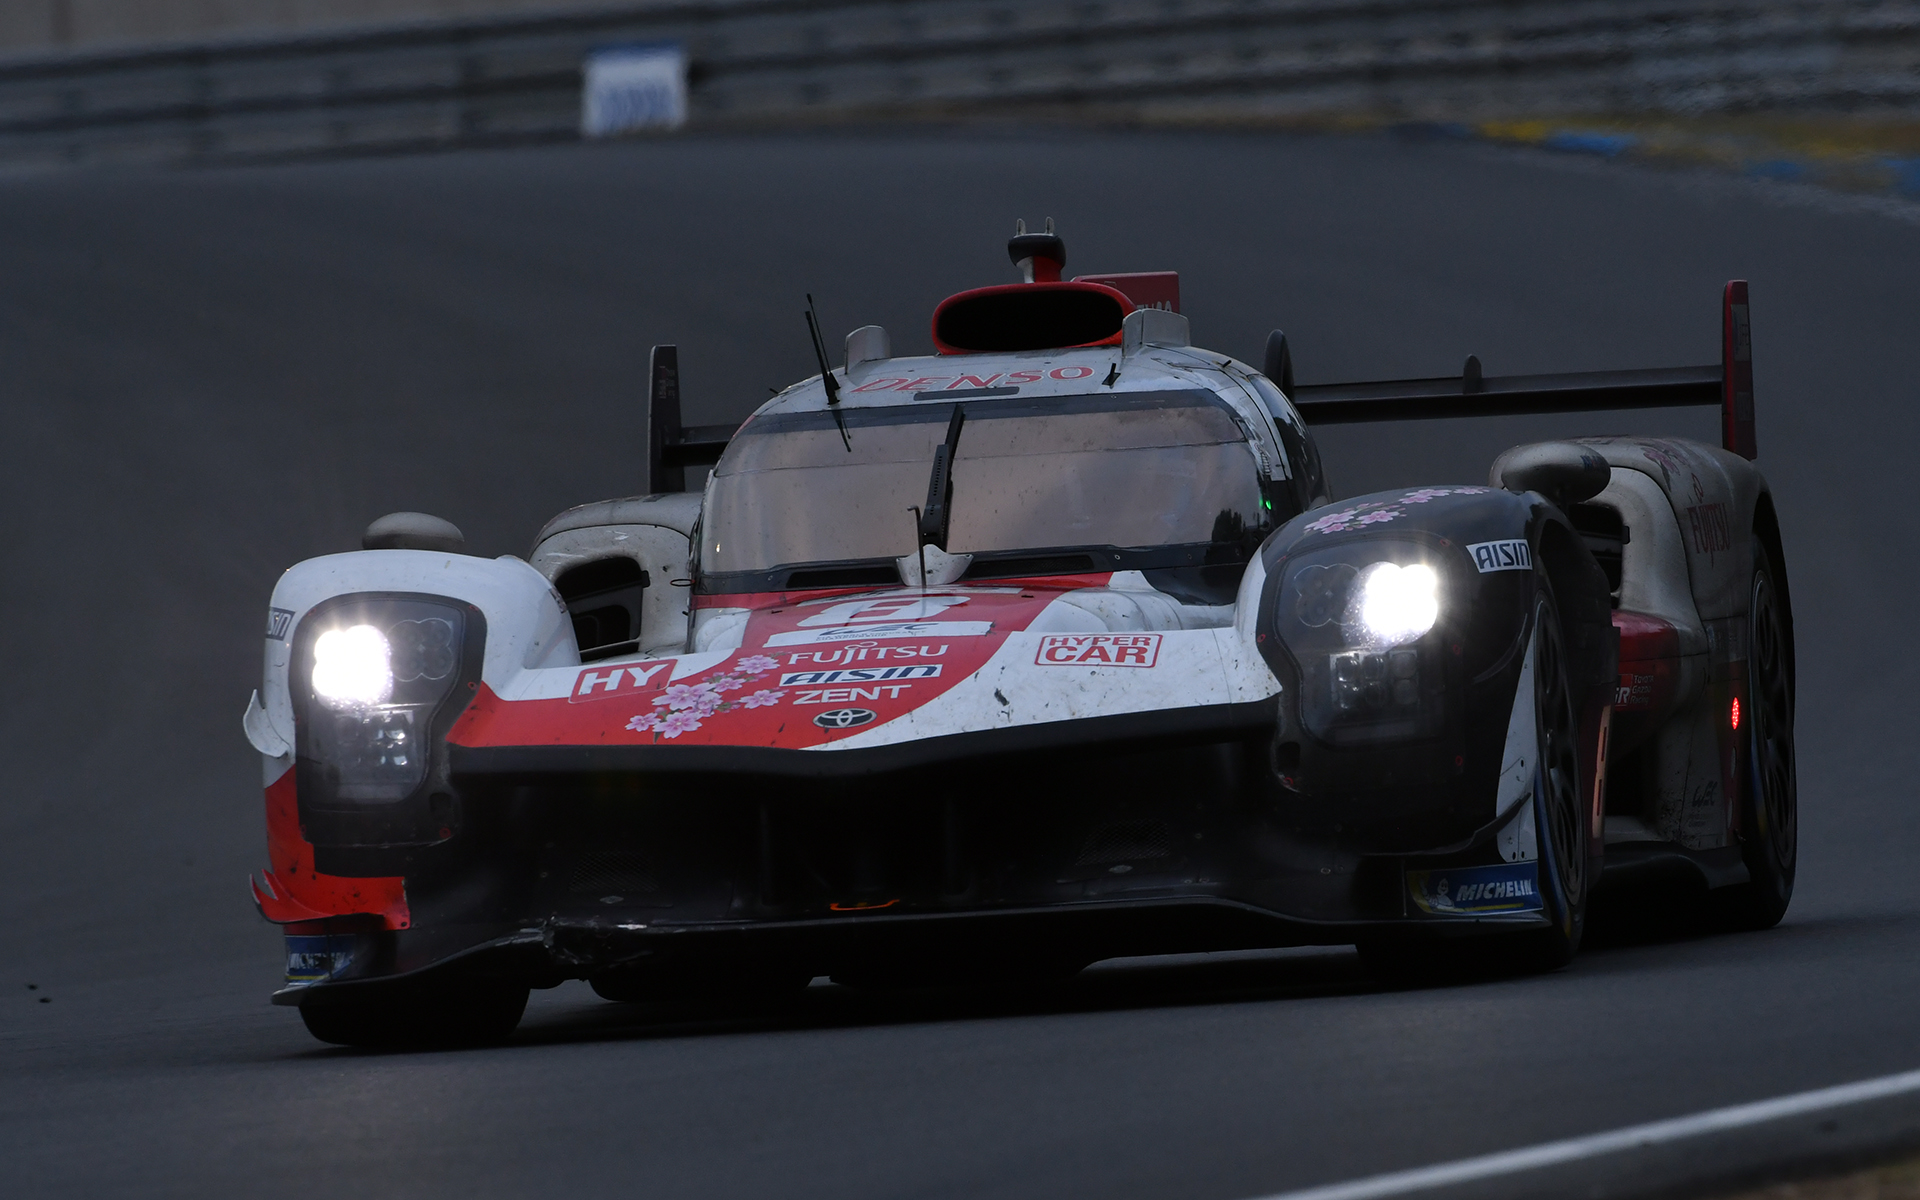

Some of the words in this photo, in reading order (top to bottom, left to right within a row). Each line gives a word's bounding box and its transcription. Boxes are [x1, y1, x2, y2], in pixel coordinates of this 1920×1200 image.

[849, 366, 1095, 394] DENSO
[1687, 502, 1731, 569] FUJITSU
[1476, 543, 1530, 569] AISIN
[267, 611, 292, 637] SIN
[787, 641, 949, 666] FUJITSU
[1049, 637, 1152, 646] HYPER
[1045, 646, 1148, 664] CAR
[578, 664, 669, 695] HY
[783, 665, 938, 685] AISIN
[792, 684, 912, 705] ZENT
[1456, 879, 1534, 902] MICHELIN
